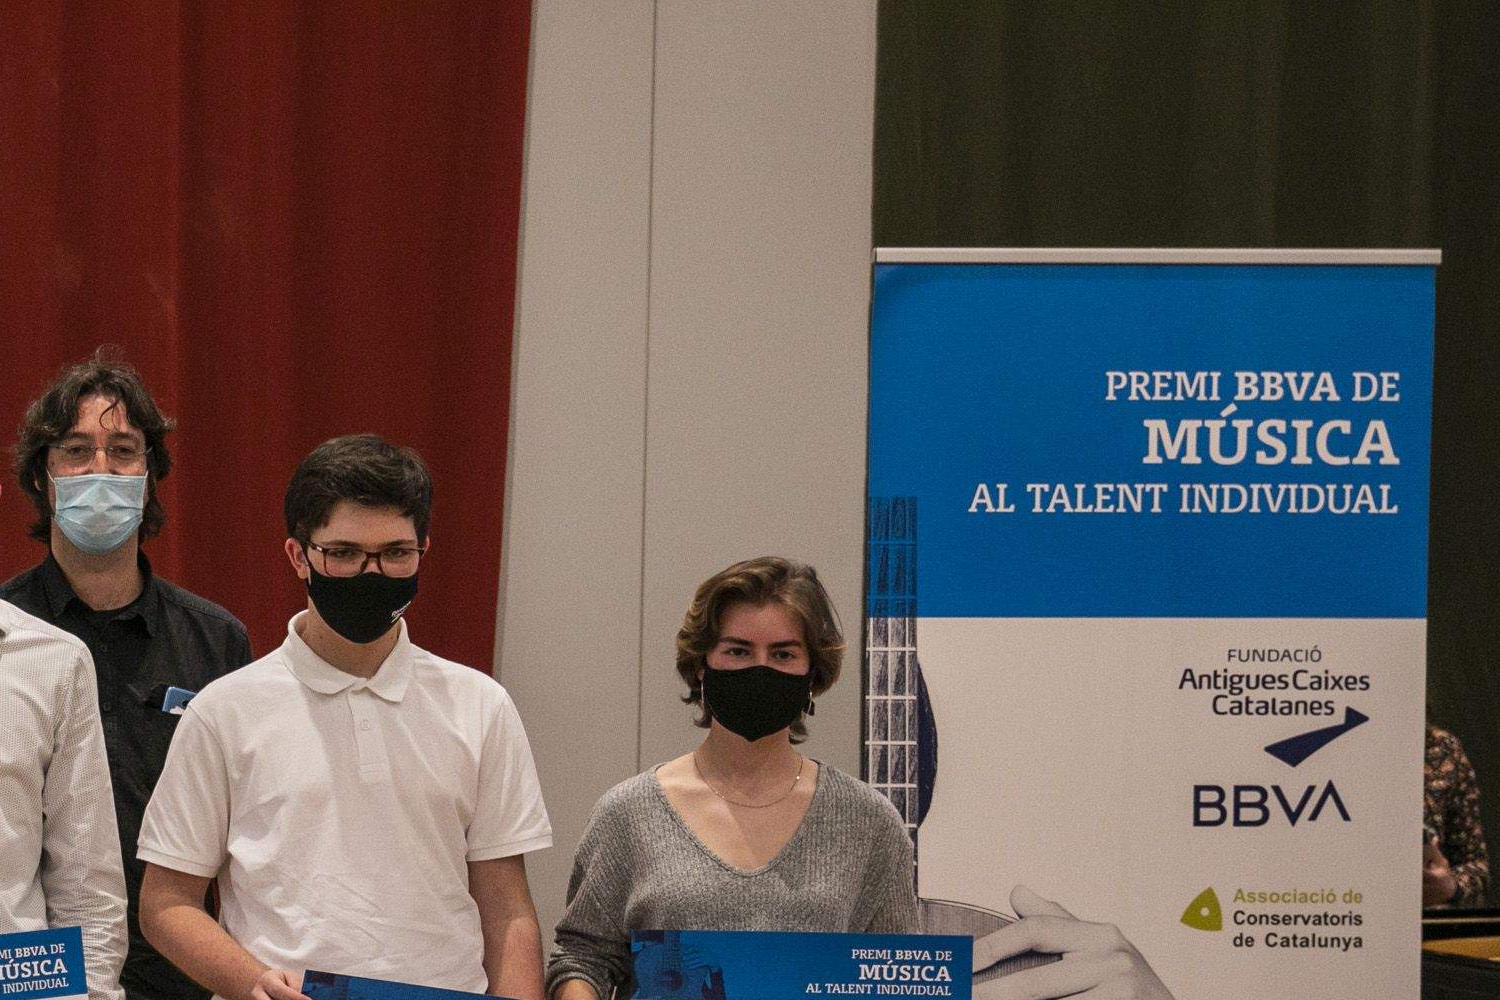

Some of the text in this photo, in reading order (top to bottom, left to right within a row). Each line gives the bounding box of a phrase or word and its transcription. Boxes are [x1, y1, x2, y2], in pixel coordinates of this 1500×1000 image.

[1105, 371, 1400, 402] PREMI BBVA DE
[1142, 403, 1400, 465] MÚSICA
[968, 483, 1398, 514] AL TALENT INDIVIDUAL
[1227, 645, 1322, 663] FUNDACIÓ
[1178, 668, 1371, 696] Antigues Caixes
[1212, 695, 1335, 716] Catalanes
[1192, 779, 1352, 827] BBVA
[1232, 888, 1363, 904] Associació de
[1232, 910, 1363, 927] Conservatoris
[14, 945, 48, 958] BBVA
[49, 943, 66, 954] DE
[1232, 932, 1363, 952] de Catalunya
[851, 948, 952, 961] PREMI BBVA DE
[858, 960, 952, 982] MÚSICA
[2, 977, 69, 994] INDIVIDUAL
[805, 982, 952, 996] AL TALENT INDIVIDUAL
